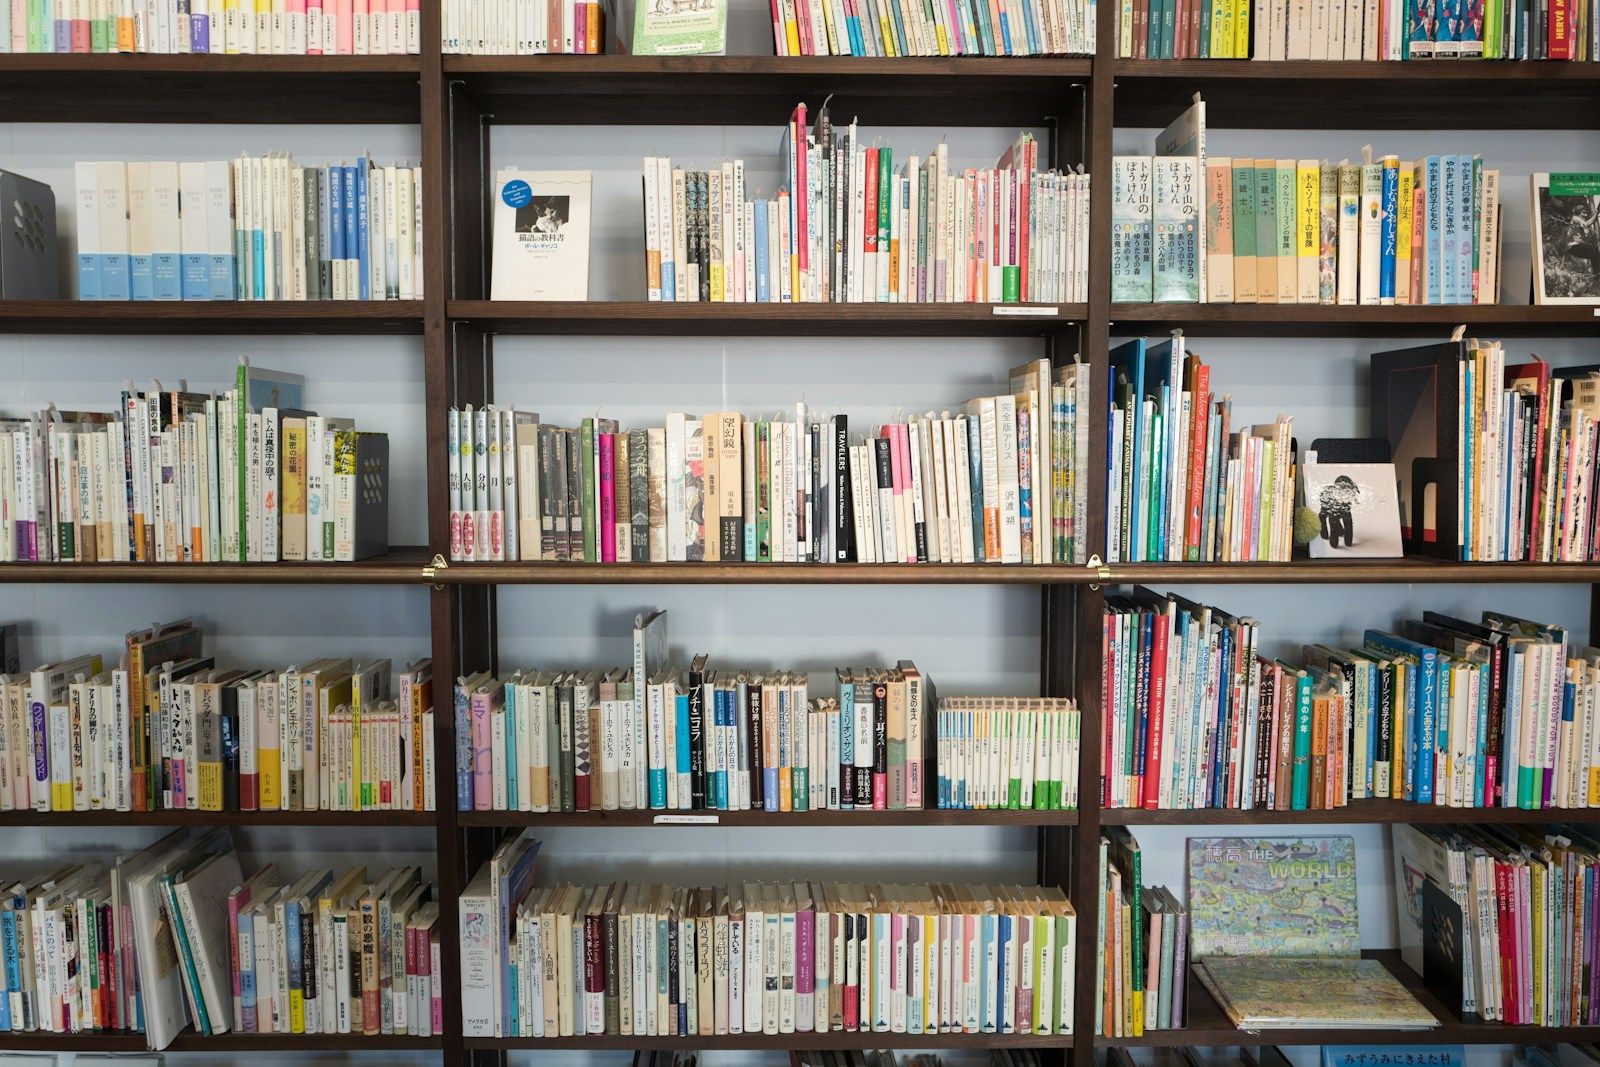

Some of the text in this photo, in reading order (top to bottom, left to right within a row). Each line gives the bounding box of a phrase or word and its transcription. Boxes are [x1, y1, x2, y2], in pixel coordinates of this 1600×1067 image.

[1556, 11, 1565, 40] HERVÉ
[1127, 162, 1137, 204] ぼうけん
[1138, 162, 1149, 215] トガリ山の
[1170, 162, 1180, 204] ぼうけん
[1182, 162, 1193, 215] トガリ山の
[1216, 172, 1225, 221] レ・ミゼラブル
[1239, 172, 1248, 206] 三銃士
[1260, 173, 1270, 207] 三銃士
[1402, 177, 1410, 220] 鏡の国のアリス
[1429, 162, 1438, 231] やかまし村の子どもたち
[1446, 161, 1455, 235] やかまし村はいつもにぎやか
[1462, 162, 1471, 232] やかまし村の春・夏・秋・冬
[712, 176, 720, 240] アブサンの置土産
[1282, 174, 1290, 250] ハックルベリー・フィンの冒険
[1305, 174, 1314, 248] トム・ソーヤーの冒険
[1386, 169, 1397, 256] あしながおじさん
[519, 234, 565, 242] 猫語の教科書
[1158, 233, 1166, 272] てっぺんの湖
[150, 398, 158, 433] 田園の食卓
[1126, 401, 1132, 409] AN
[1199, 391, 1208, 417] Silver
[265, 418, 274, 481] トムは真夜中の庭で
[1001, 403, 1012, 459] 完全版アリス
[1197, 420, 1206, 447] Spoon
[289, 433, 297, 473] 秘密の花園
[636, 435, 647, 476] うつろ舟
[1196, 449, 1204, 461] for
[463, 473, 472, 492] 人形
[478, 473, 486, 491] 分身
[491, 478, 498, 487] 月
[505, 477, 513, 487] 夢
[1194, 466, 1204, 501] Children
[88, 689, 98, 742] アメリカの鱒釣り
[289, 680, 299, 752] シャボン玉ホリデー
[690, 684, 702, 742] プチ・ニコラ
[910, 681, 918, 720] 蜘蛛女のキス
[1281, 684, 1293, 758] シルバー・レイクの岸辺で
[1423, 661, 1434, 751] マザーグースとあそぶ本
[305, 692, 314, 752] 赤塚不二夫の特集
[606, 703, 614, 759] チェーホフ・ユモレスカ
[624, 703, 632, 758] チェーホフ・ユモレスカ
[718, 729, 726, 769] うたかたの日々
[729, 729, 737, 769] うたかたの日々
[1205, 845, 1353, 880] 穂高 THE WORLD
[4, 917, 16, 964] 旅をする木
[46, 917, 55, 959] バスにのって
[362, 914, 374, 955] 数の悪魔
[393, 923, 405, 982] 橋本治と内田樹
[1345, 1053, 1450, 1065] みずうみにきえた村
